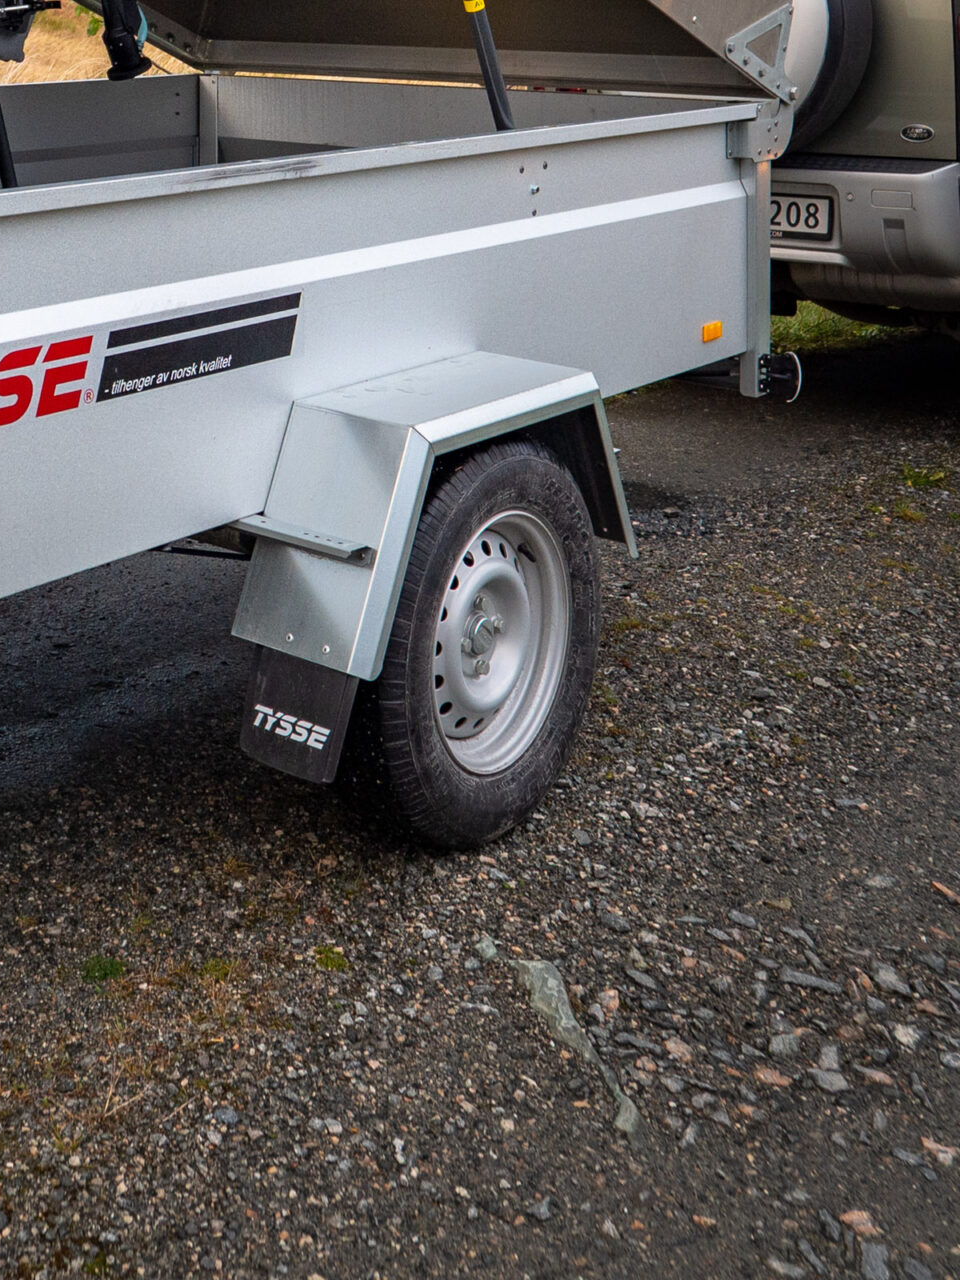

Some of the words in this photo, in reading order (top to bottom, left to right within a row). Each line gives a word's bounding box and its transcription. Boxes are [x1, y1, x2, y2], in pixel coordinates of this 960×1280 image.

[111, 373, 156, 395] tilhenger
[156, 370, 171, 384] av
[170, 361, 198, 381] norsk
[198, 354, 233, 375] kvalitet
[253, 703, 331, 750] TYSSE
